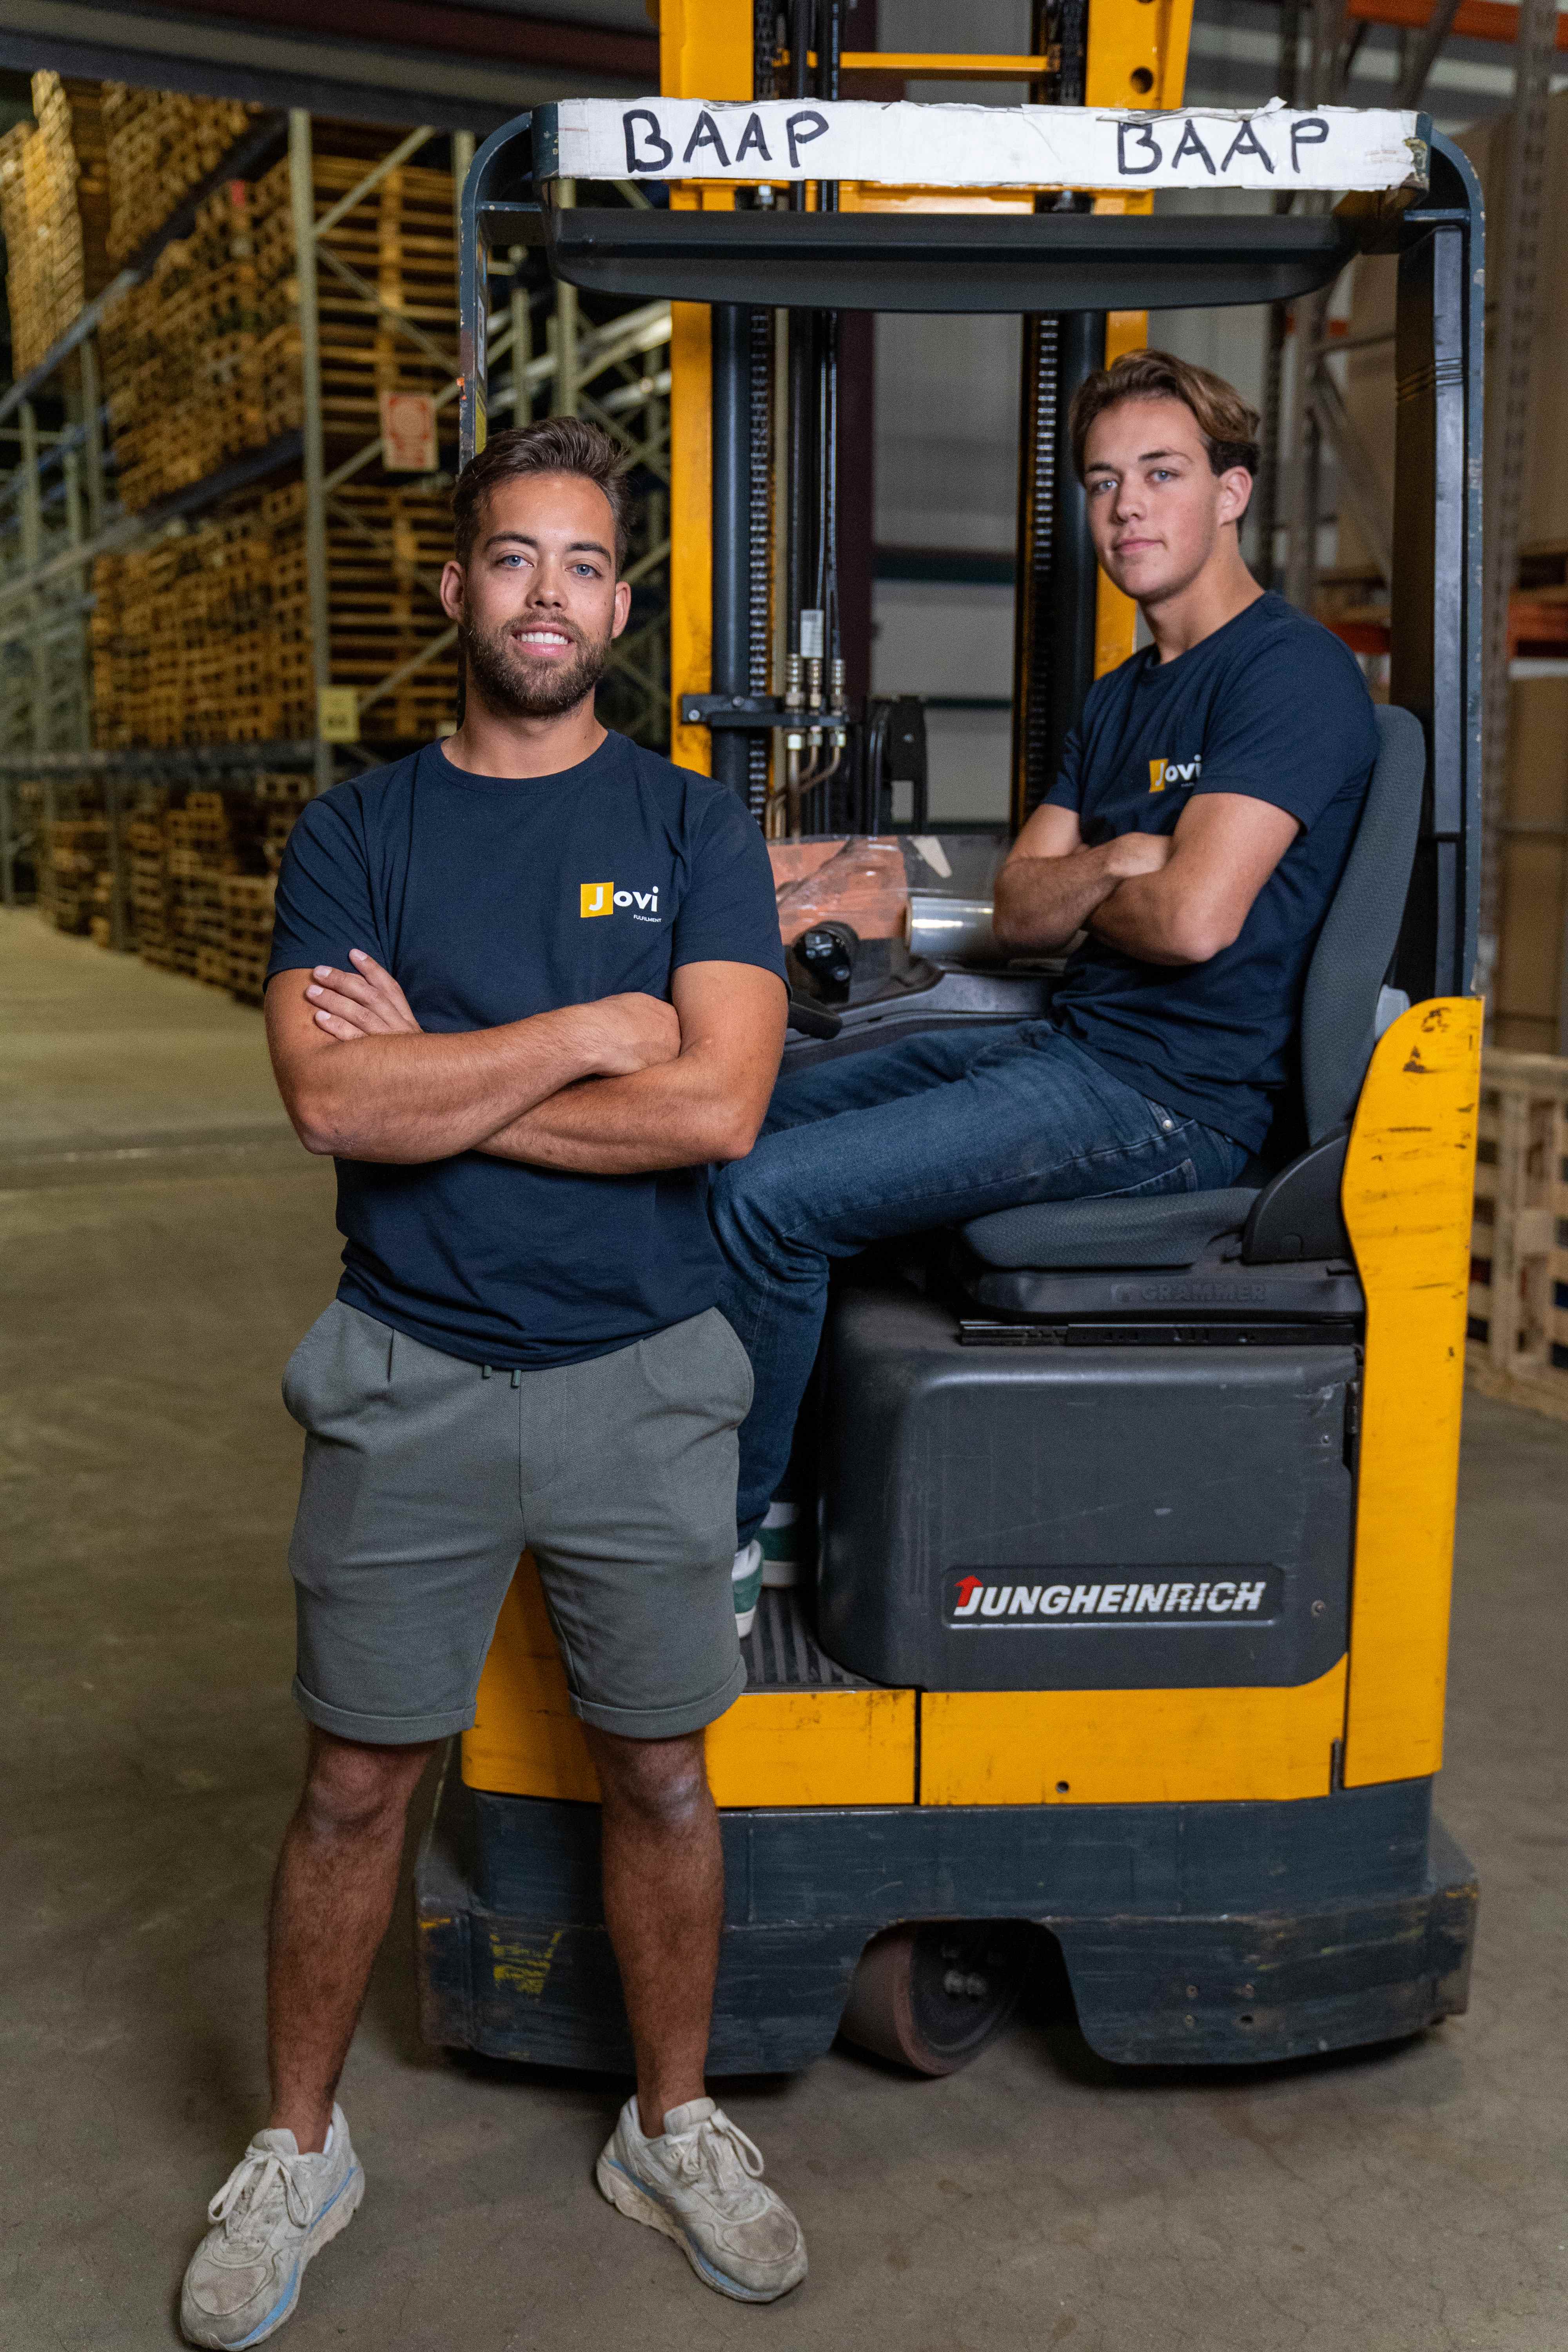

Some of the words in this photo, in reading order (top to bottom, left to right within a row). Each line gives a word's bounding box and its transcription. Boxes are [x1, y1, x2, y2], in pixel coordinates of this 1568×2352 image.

[622, 109, 829, 173] BAAP
[1117, 117, 1329, 176] BAAP
[1155, 754, 1202, 786] Jovi
[589, 886, 659, 912] Jovi
[633, 914, 662, 922] FULFILMENT
[953, 1581, 1267, 1617] JUNGHEINRICH
